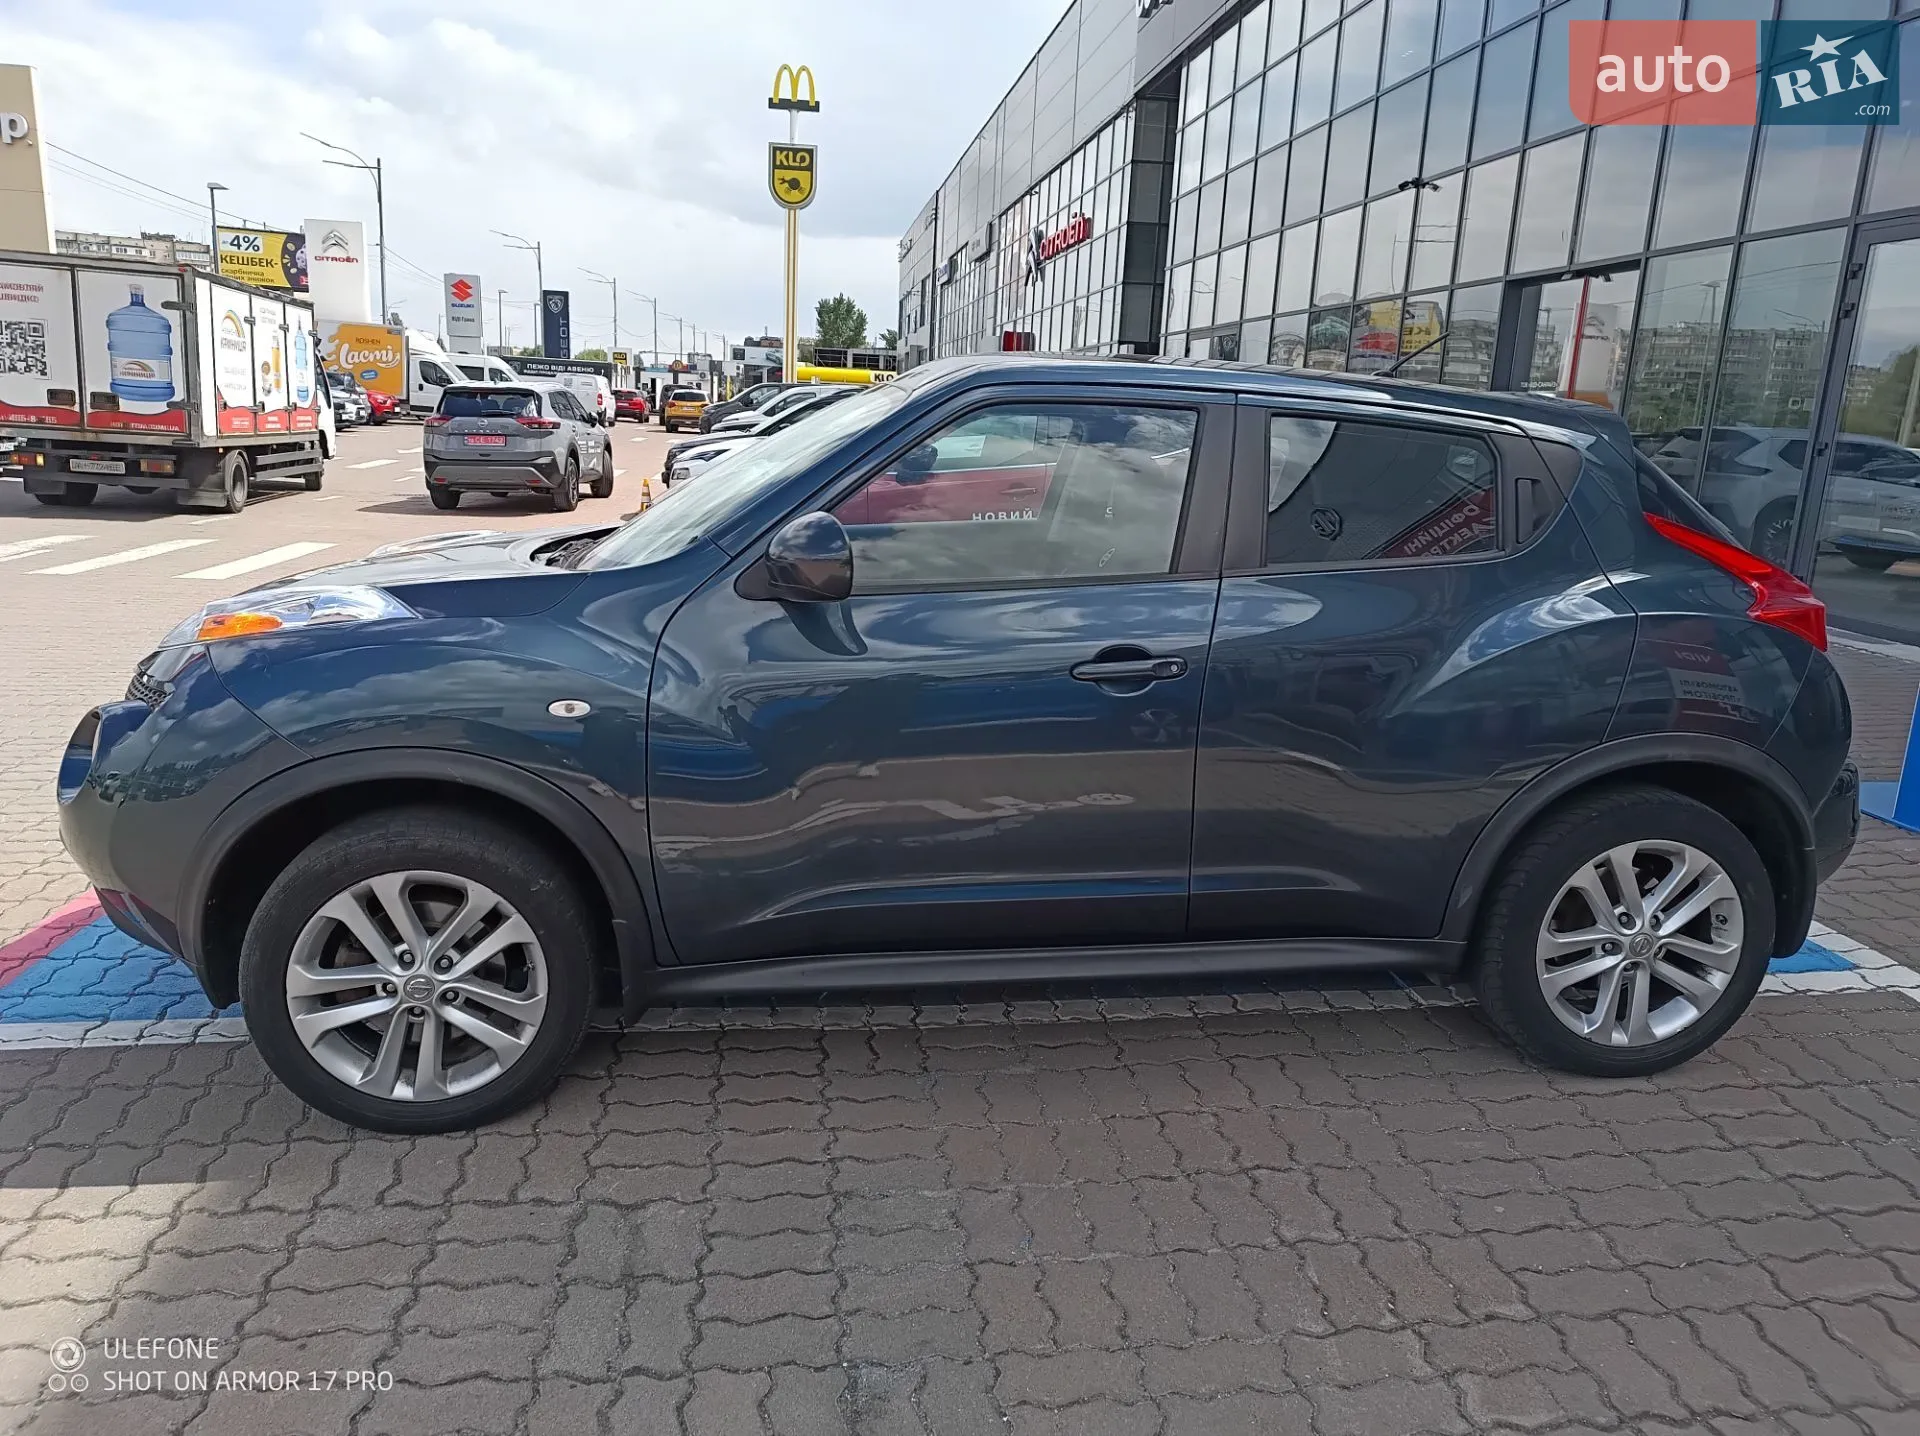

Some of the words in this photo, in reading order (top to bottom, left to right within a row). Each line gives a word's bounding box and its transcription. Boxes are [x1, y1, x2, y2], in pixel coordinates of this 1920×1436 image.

[775, 149, 811, 167] KLO
[229, 234, 260, 252] 4%
[220, 254, 279, 268] КЕШБЕК-
[526, 363, 550, 371] ПЕЖО
[550, 364, 566, 372] ВІДІ
